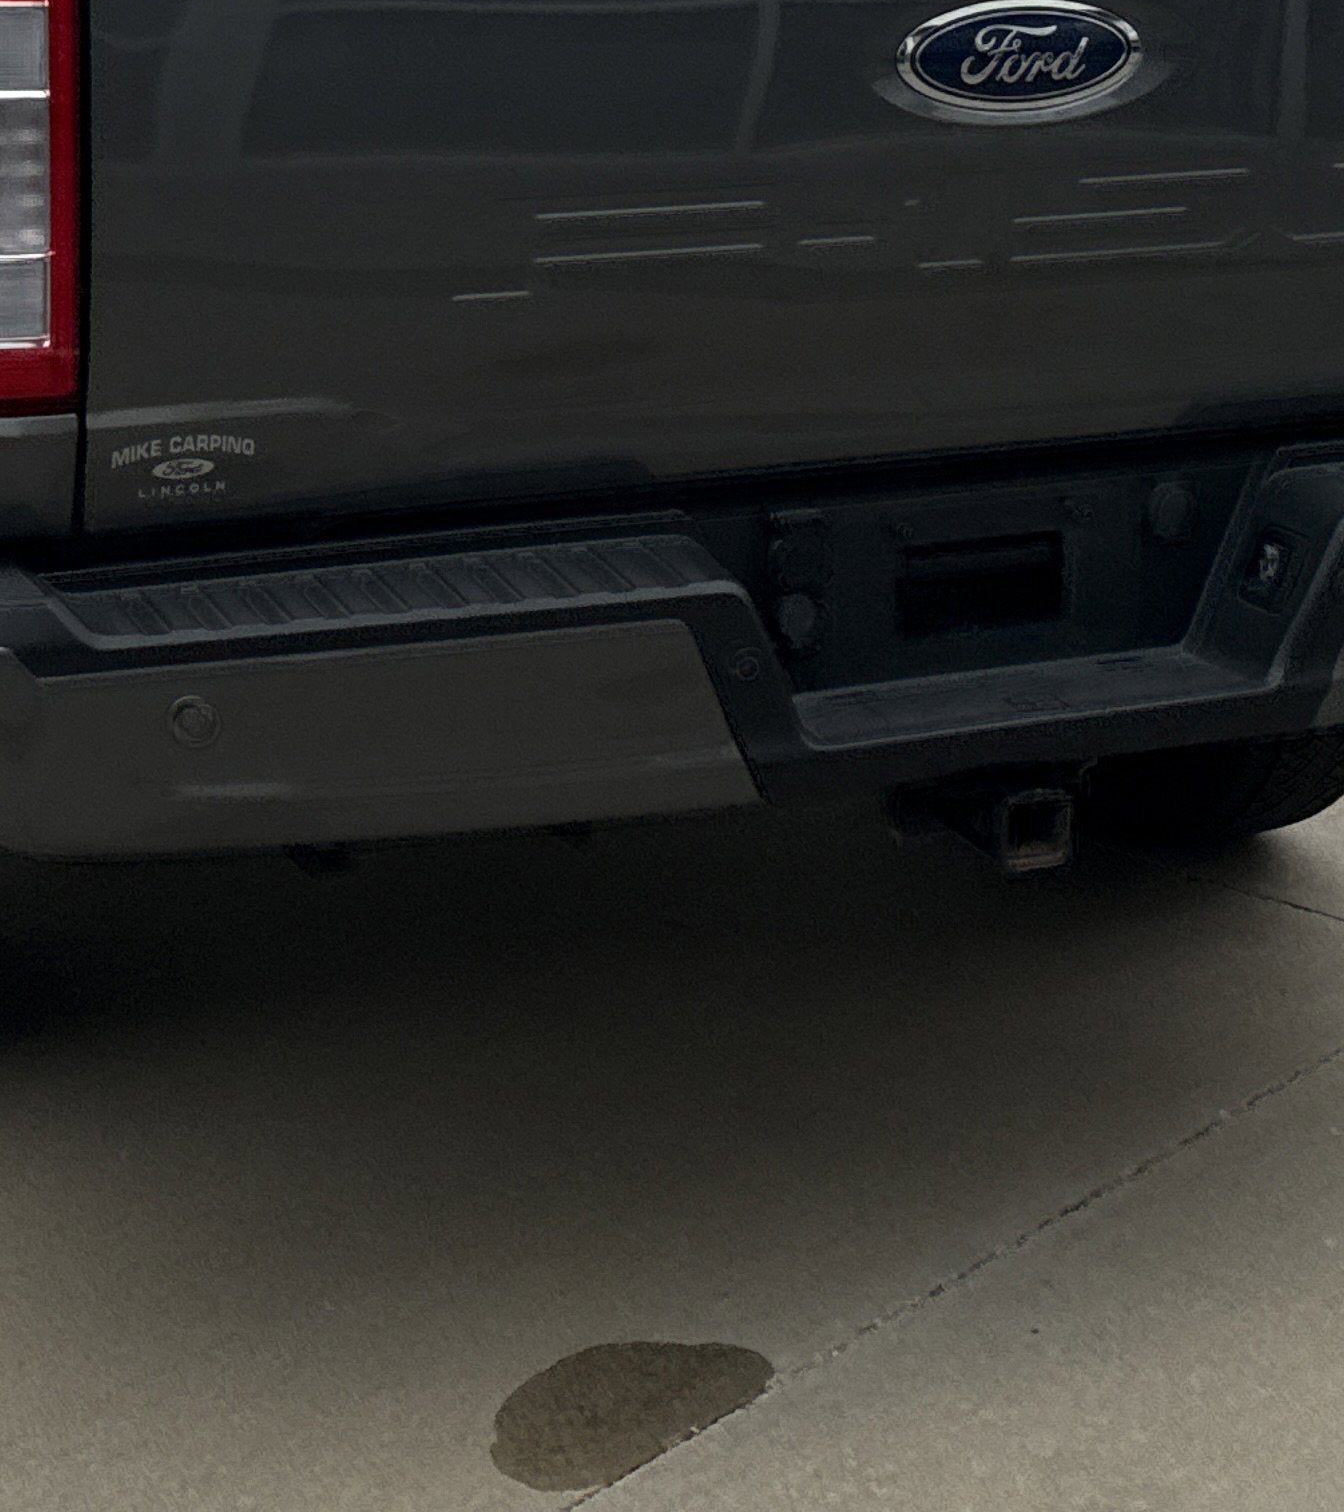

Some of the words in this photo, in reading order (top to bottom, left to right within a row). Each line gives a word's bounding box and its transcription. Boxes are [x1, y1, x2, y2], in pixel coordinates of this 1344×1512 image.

[960, 24, 1090, 85] Ford
[110, 439, 162, 469] MIKE
[170, 434, 256, 456] CARPINO
[138, 481, 226, 499] LINCOLN
